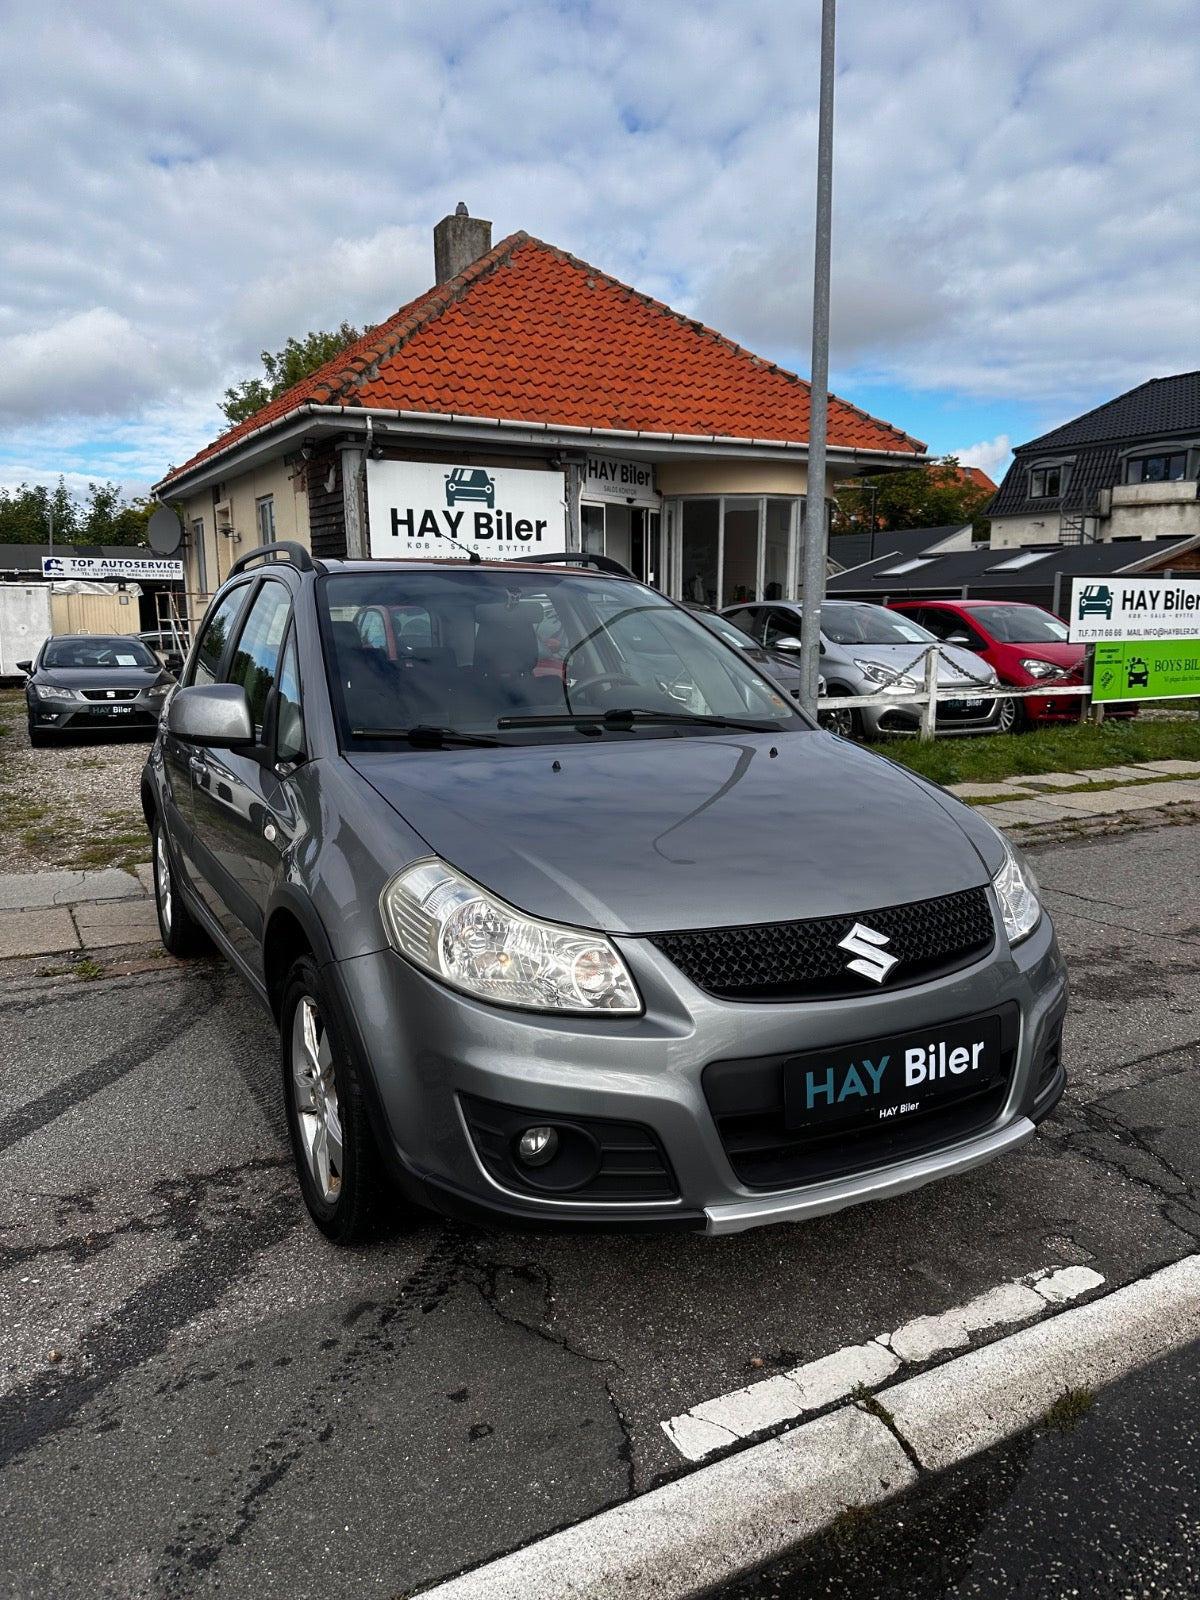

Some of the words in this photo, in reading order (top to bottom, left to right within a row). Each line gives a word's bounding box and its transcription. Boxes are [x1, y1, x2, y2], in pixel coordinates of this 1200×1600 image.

[588, 459, 618, 481] HAY
[620, 464, 651, 486] Biler
[390, 508, 465, 538] HAY
[474, 509, 547, 541] Biler
[407, 541, 430, 549] KØB
[498, 544, 532, 552] BYTTE
[70, 559, 94, 567] TOP
[100, 560, 181, 569] AUTOSERVICE
[1122, 590, 1161, 610] HAY
[1154, 659, 1182, 672] BOYS
[806, 1055, 890, 1109] HAY
[905, 1041, 985, 1087] Biler
[879, 1106, 898, 1119] HAY
[900, 1102, 920, 1114] Biler
